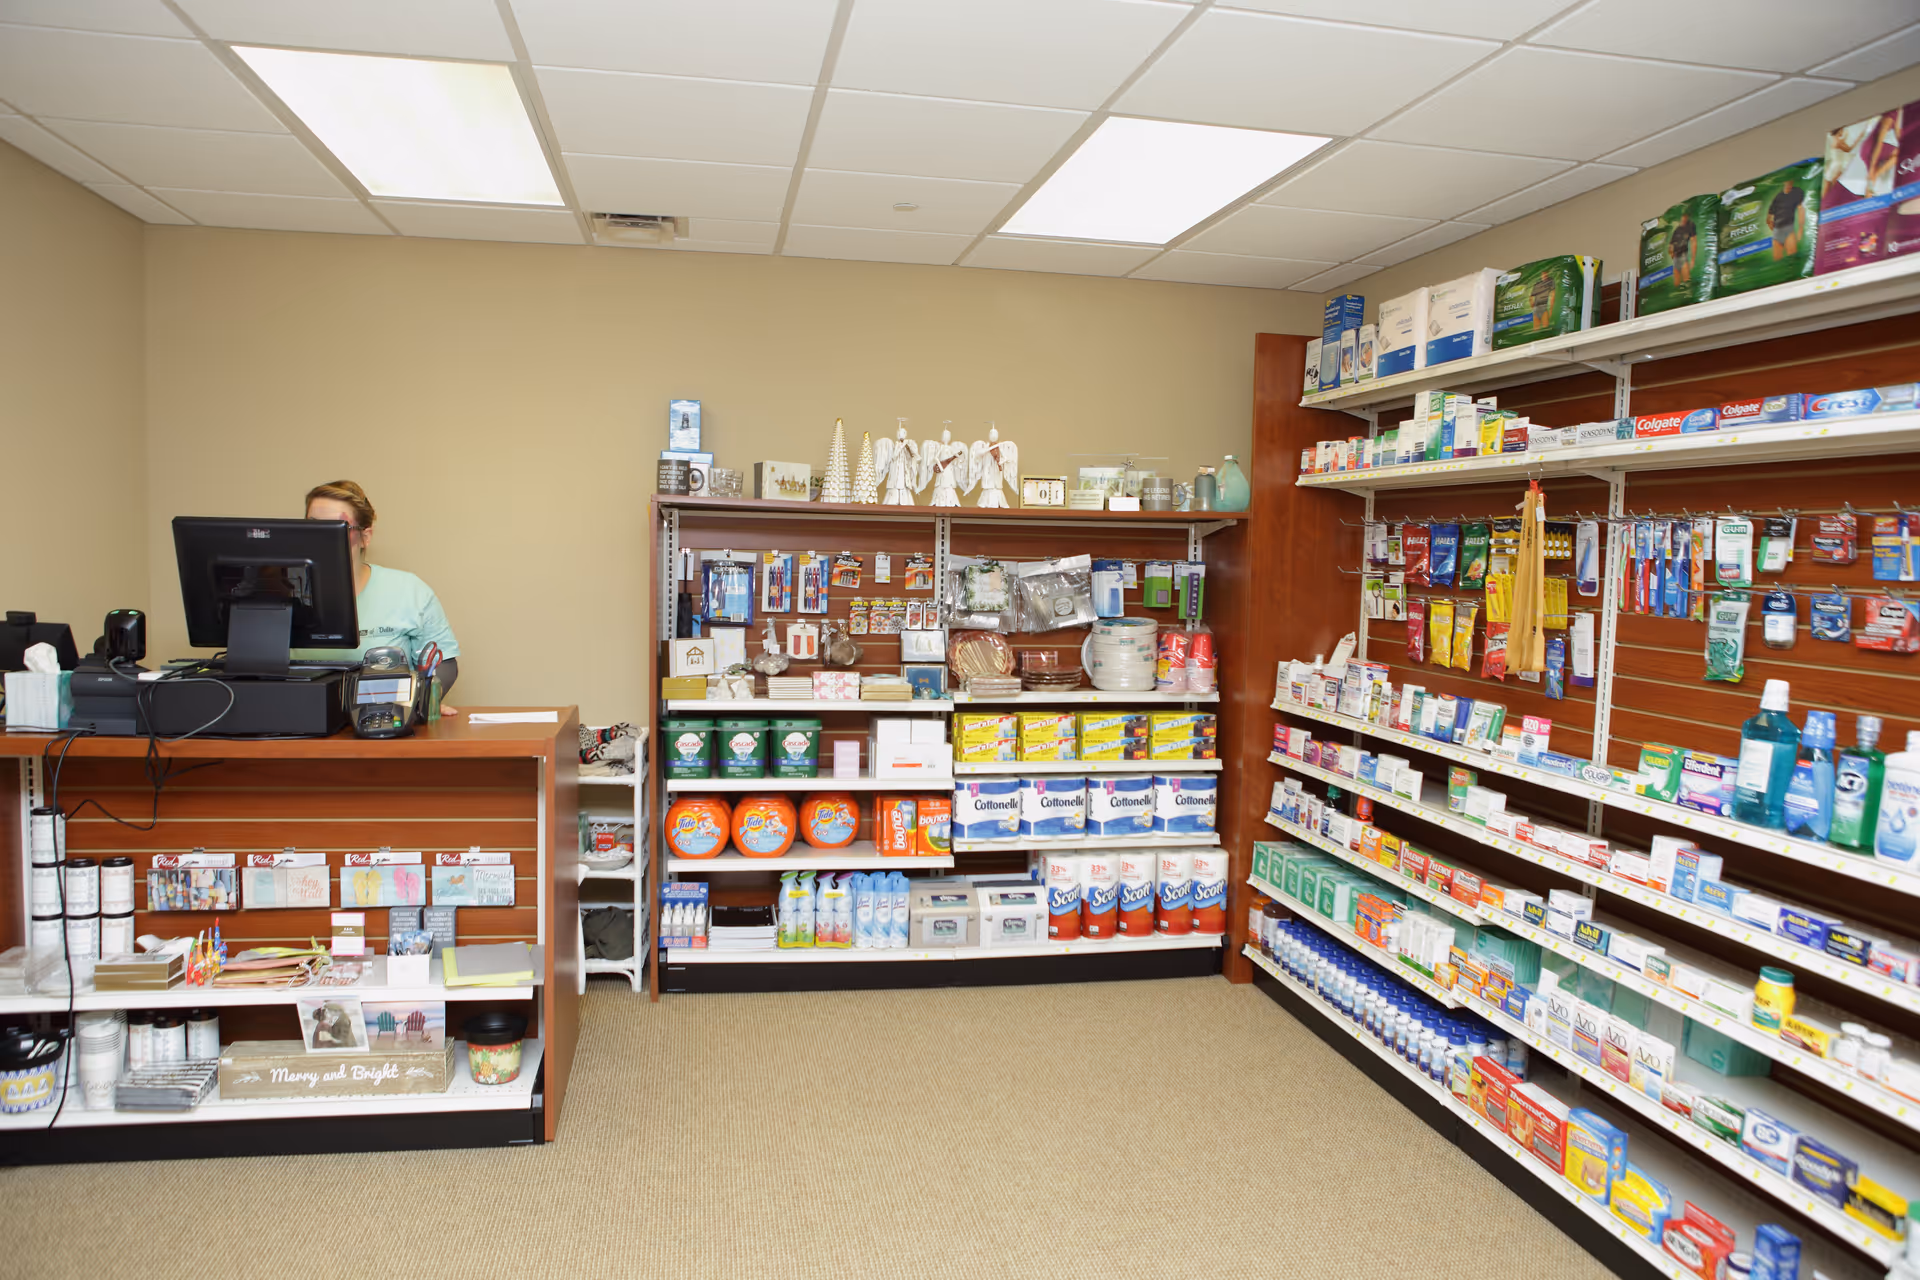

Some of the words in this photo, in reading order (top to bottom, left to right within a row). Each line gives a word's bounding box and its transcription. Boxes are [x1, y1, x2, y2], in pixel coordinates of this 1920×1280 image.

[1722, 403, 1760, 418] Colgate
[1811, 393, 1871, 413] Crest
[1580, 426, 1616, 438] SENSODYNE
[1637, 416, 1682, 433] Colgate
[674, 739, 704, 750] Cascade
[729, 738, 758, 749] Cascade
[781, 737, 810, 749] Cascade
[1684, 758, 1722, 778] Efferdent
[678, 816, 697, 830] Tide
[745, 815, 765, 830] Tide
[815, 808, 834, 821] Tide
[919, 813, 949, 826] bounce
[893, 808, 907, 850] bounce
[158, 855, 177, 867] Red
[253, 854, 273, 865] Red
[350, 853, 368, 863] Red
[441, 853, 457, 864] Red
[1403, 848, 1425, 866] TYLENOL
[1429, 860, 1452, 878] TYLENOL
[1051, 883, 1081, 908] Scott
[1092, 881, 1118, 907] Scott
[1121, 881, 1151, 903] Scott
[1163, 879, 1193, 902] Scott
[1195, 878, 1226, 901] Scott
[1525, 902, 1543, 918] Advil
[1578, 923, 1600, 939] Advil
[1548, 998, 1569, 1019] AZO
[1575, 1012, 1597, 1034] AZO
[1606, 1025, 1627, 1049] AZO
[1636, 1046, 1661, 1069] AZO
[270, 1067, 319, 1088] Merry
[323, 1064, 346, 1080] and
[351, 1063, 399, 1086] Bright
[1473, 1061, 1506, 1090] ThermaCare
[1509, 1088, 1558, 1129] ThermaCare
